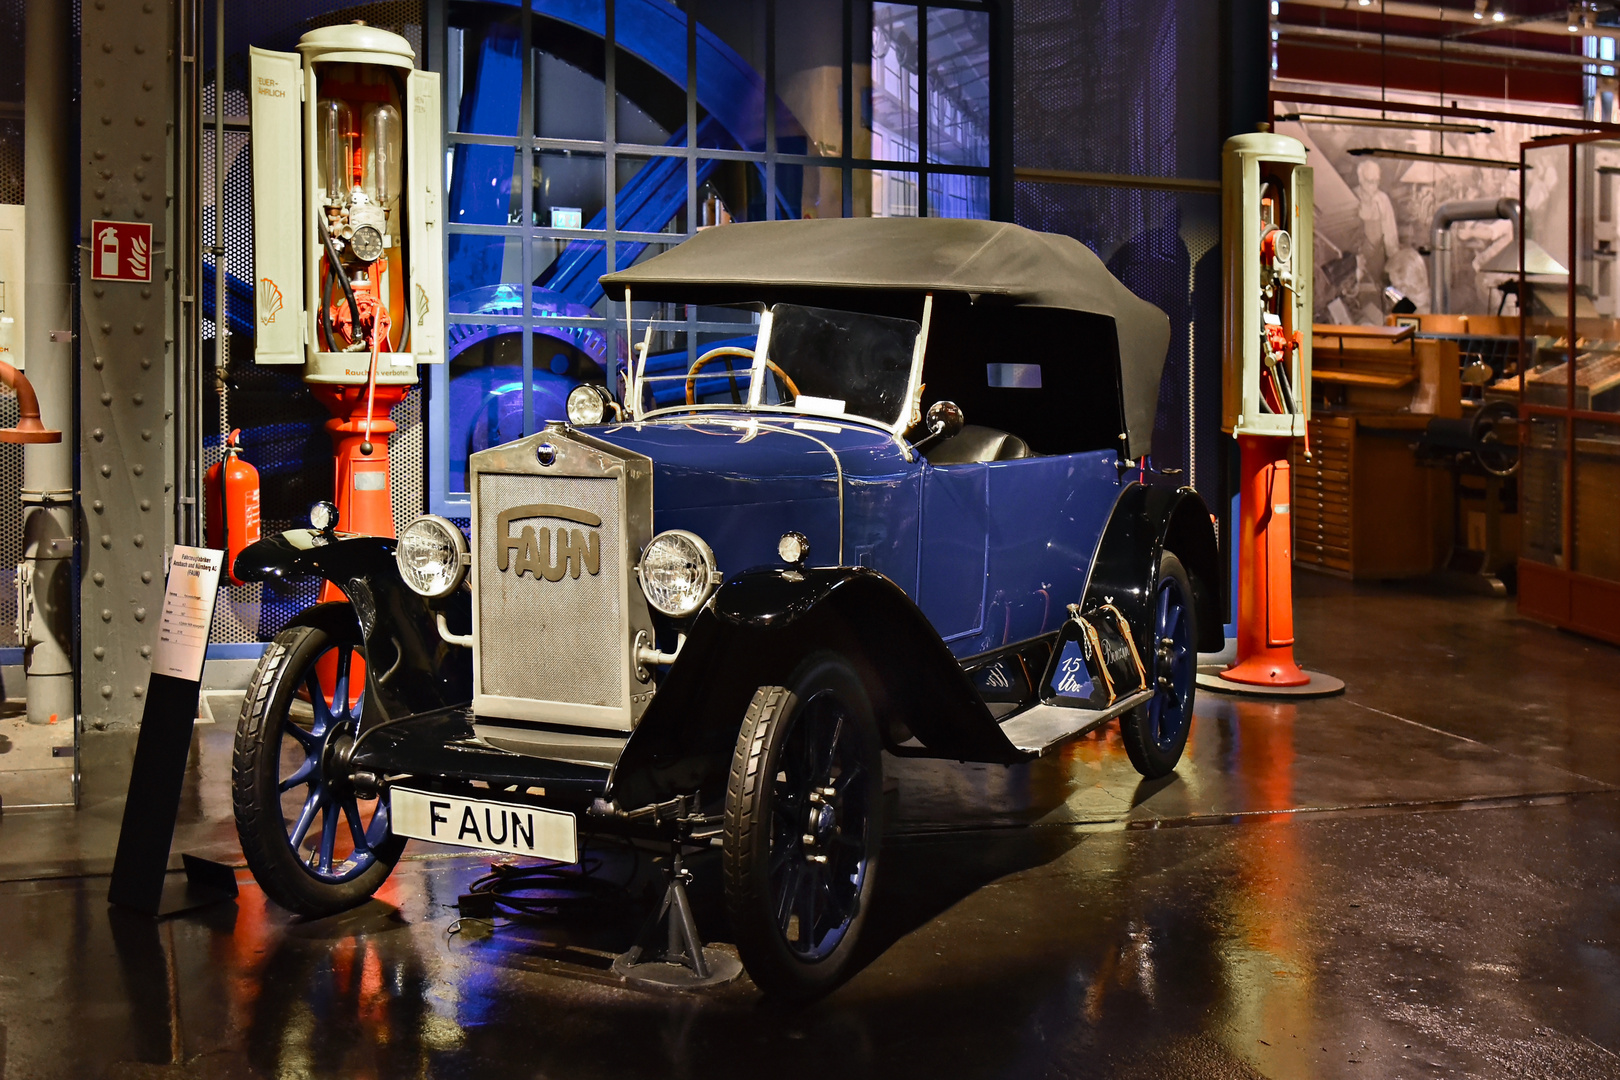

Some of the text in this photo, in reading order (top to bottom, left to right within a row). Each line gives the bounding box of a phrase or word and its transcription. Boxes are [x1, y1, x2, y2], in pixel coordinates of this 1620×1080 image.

[345, 368, 379, 376] Rauchn
[497, 503, 601, 582] FAUN
[1062, 657, 1083, 672] 15
[1101, 638, 1130, 666] Benzin
[429, 800, 535, 850] FAUN
